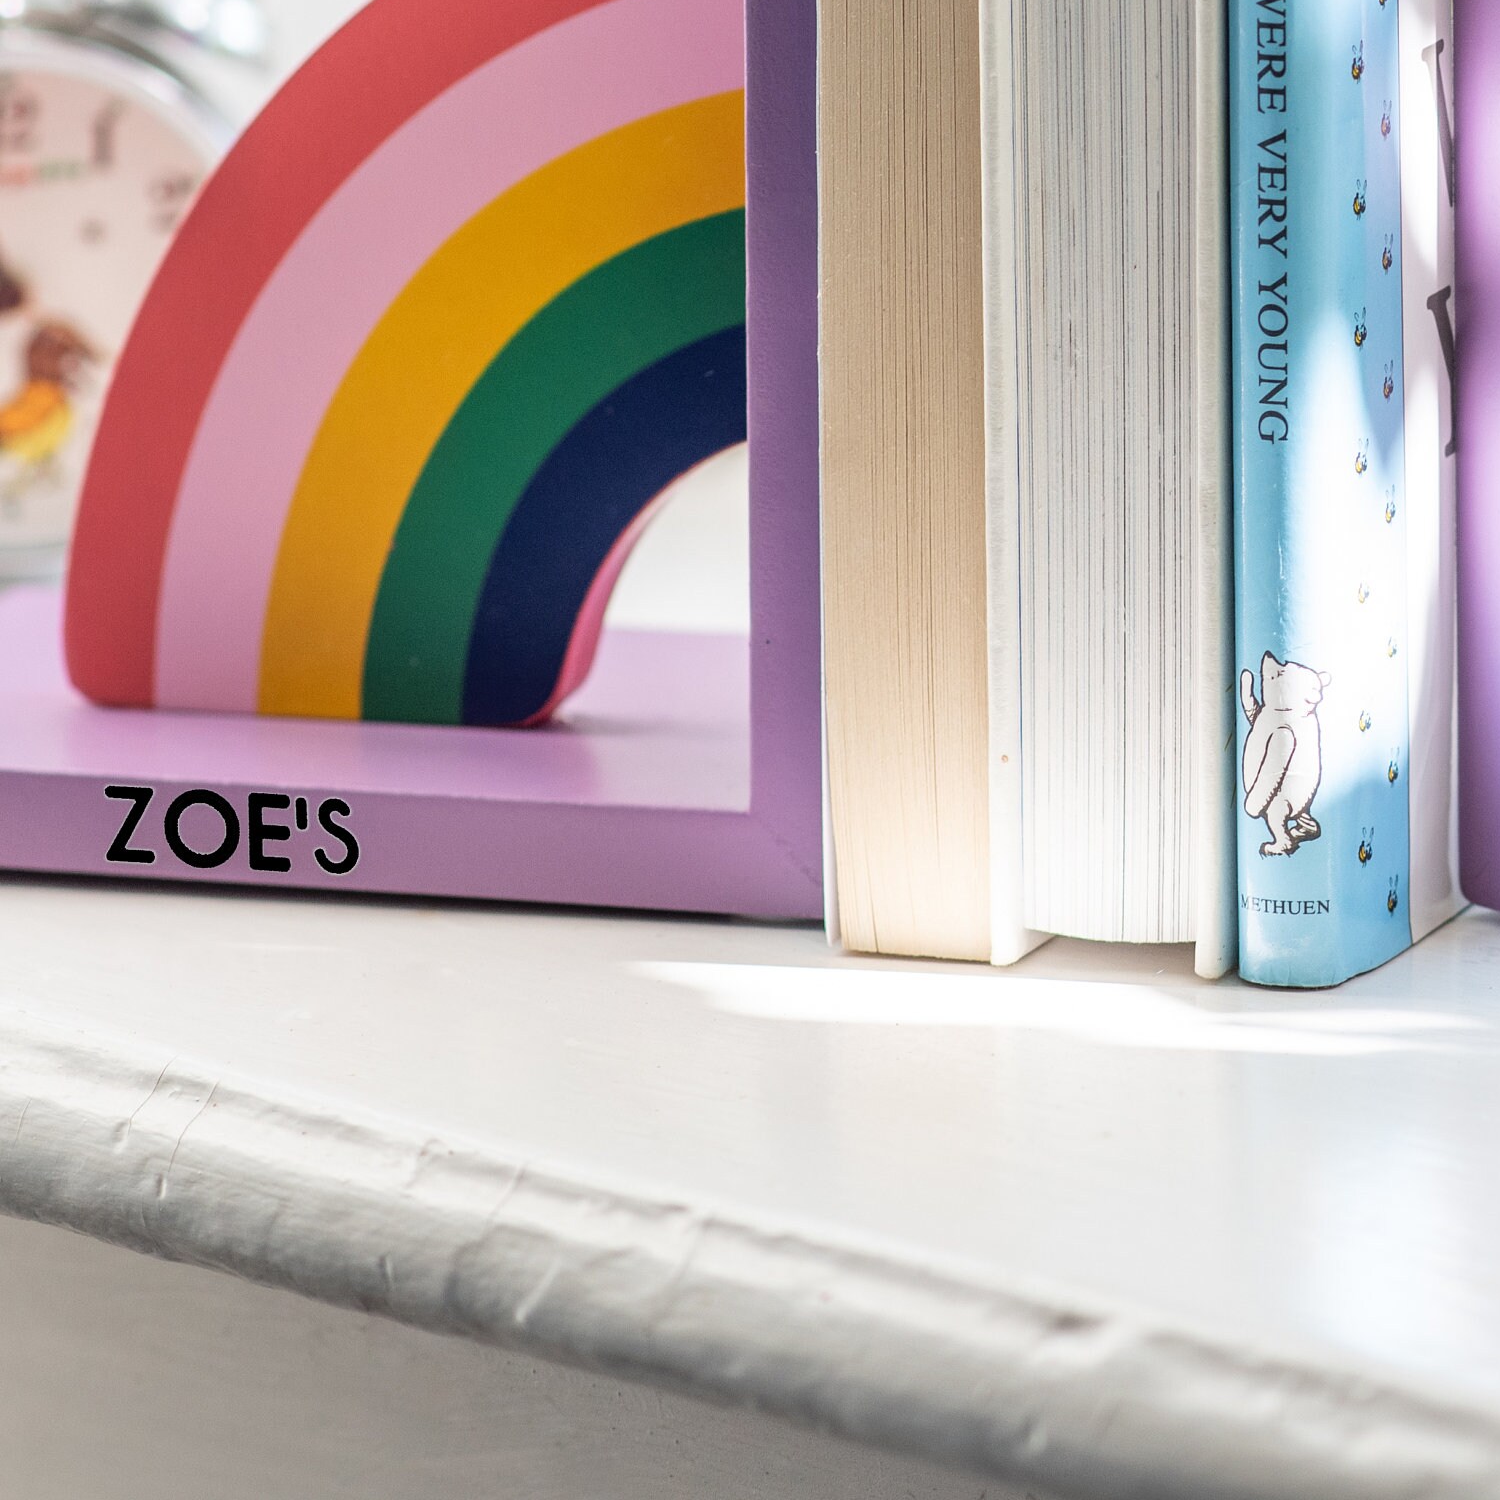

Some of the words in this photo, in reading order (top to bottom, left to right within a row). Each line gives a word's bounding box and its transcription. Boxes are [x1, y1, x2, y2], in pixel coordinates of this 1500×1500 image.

[1256, 128, 1288, 259] VERY
[1257, 271, 1289, 445] YOUNG
[103, 784, 361, 876] ZOE'S
[1240, 893, 1331, 916] METHUEN
